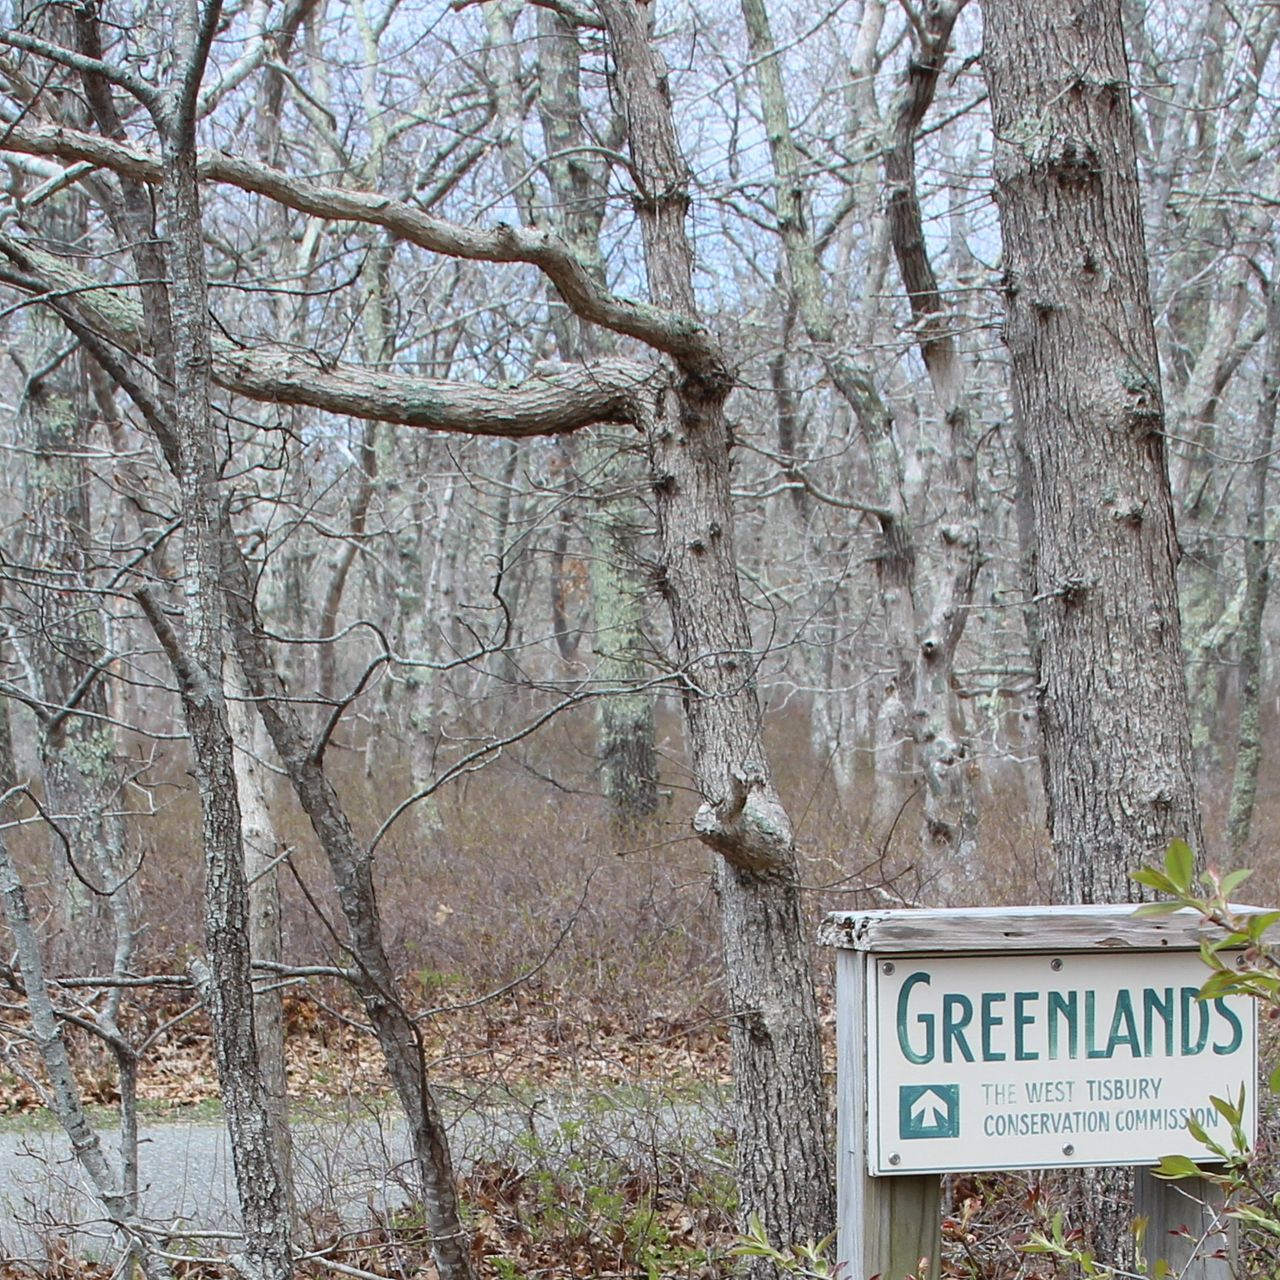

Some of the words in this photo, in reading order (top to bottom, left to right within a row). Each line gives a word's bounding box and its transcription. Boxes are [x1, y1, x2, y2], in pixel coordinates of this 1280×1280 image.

[896, 972, 1244, 1065] GREENLANDS
[982, 1083, 1017, 1105] THE
[1025, 1081, 1075, 1103] WEST
[1086, 1078, 1162, 1101] TISBURY
[984, 1111, 1110, 1137] CONSERVATION
